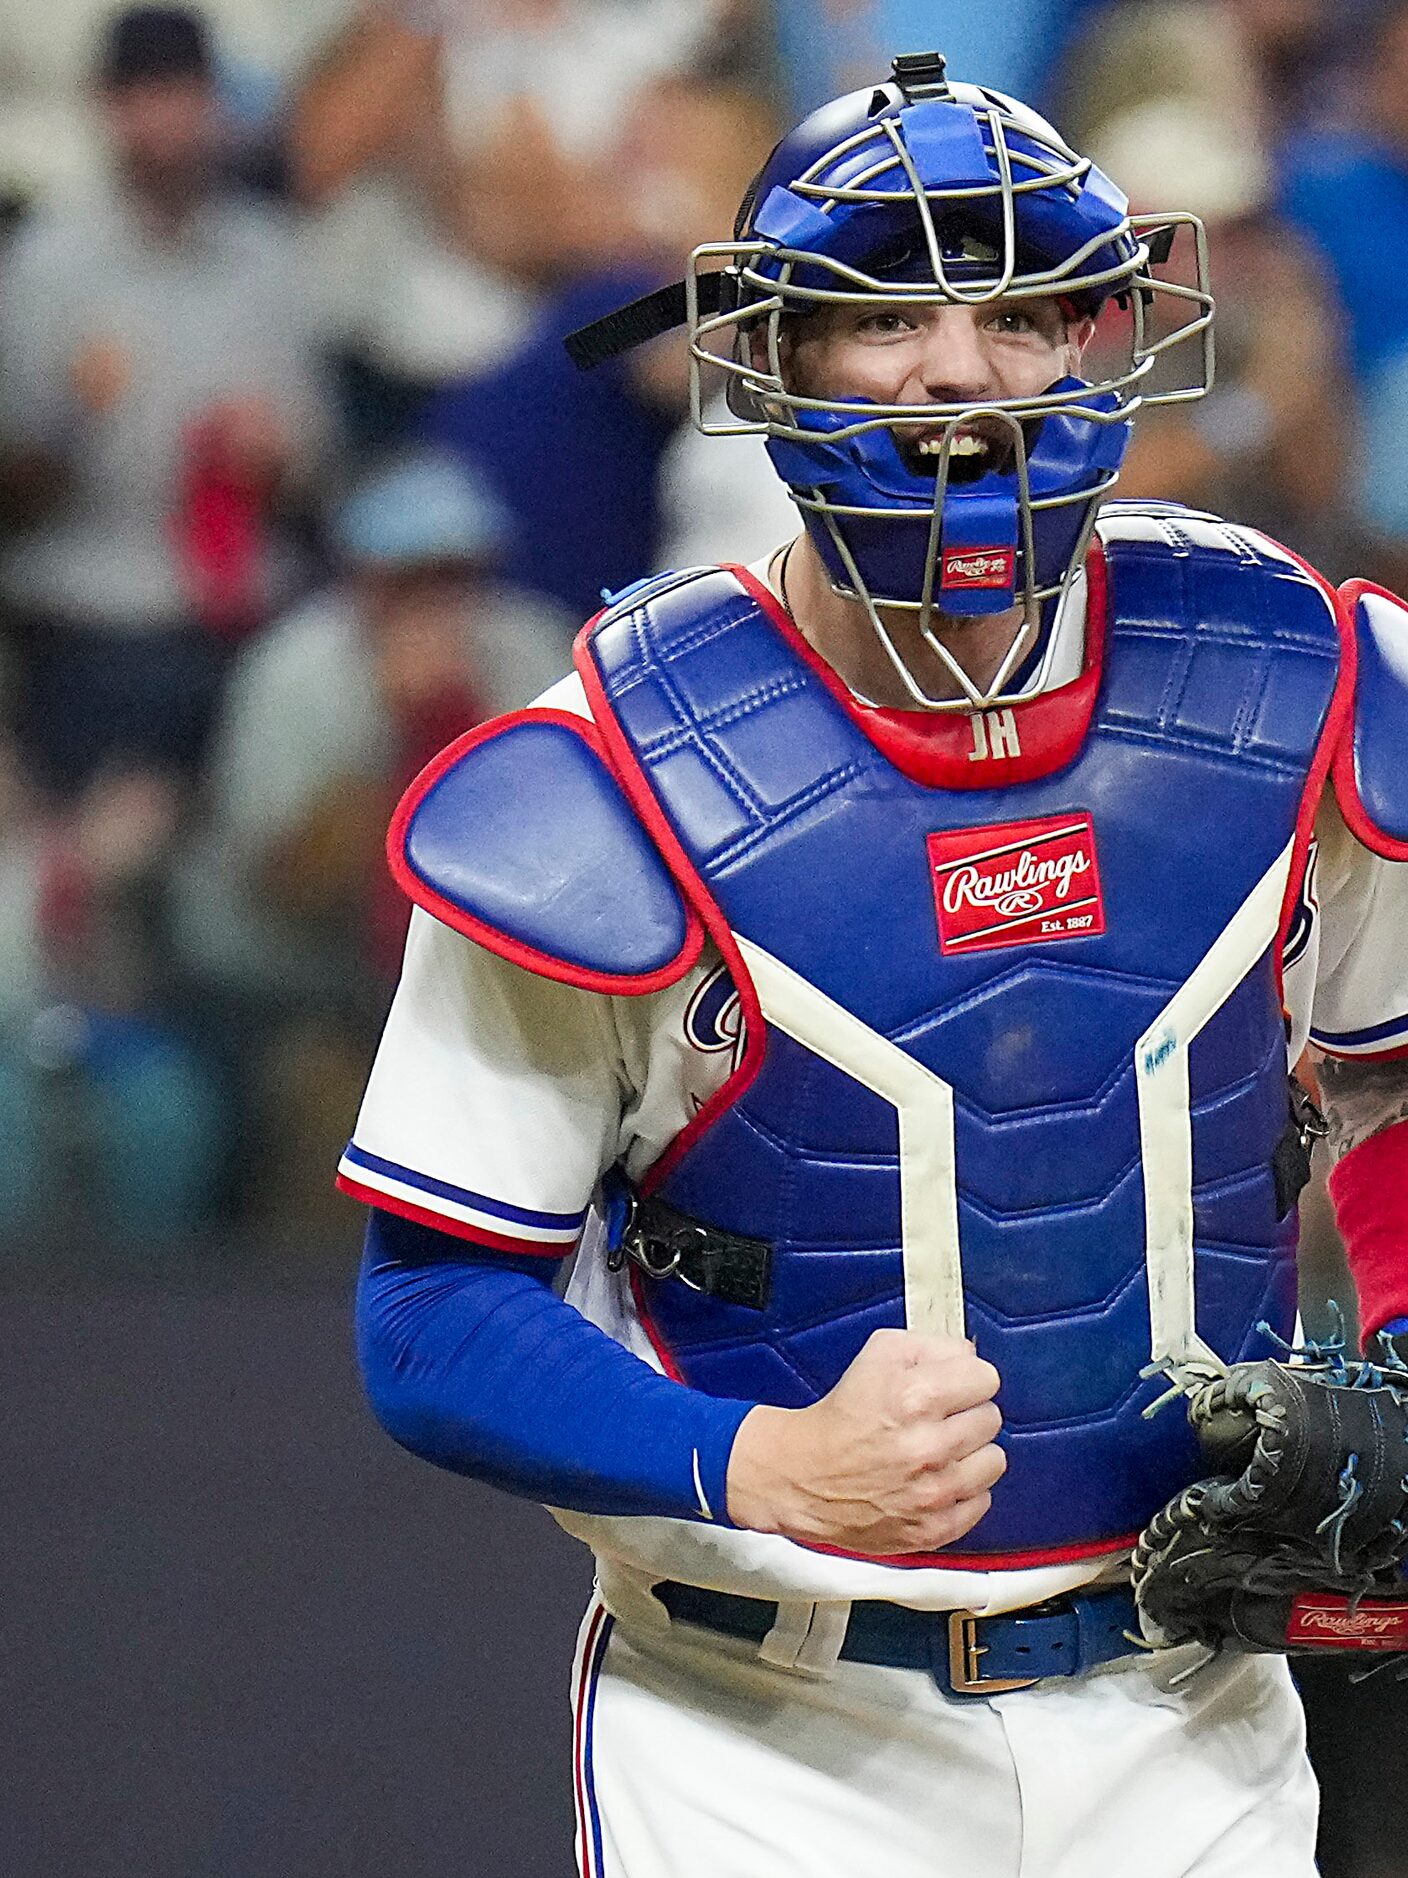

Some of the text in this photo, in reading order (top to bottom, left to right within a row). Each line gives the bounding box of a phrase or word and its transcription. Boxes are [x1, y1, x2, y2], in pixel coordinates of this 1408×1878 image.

[968, 708, 1022, 761] JH
[943, 850, 1091, 914] Rawlings
[1041, 914, 1094, 933] Est. 1887
[1301, 1610, 1404, 1635] Rawlings
